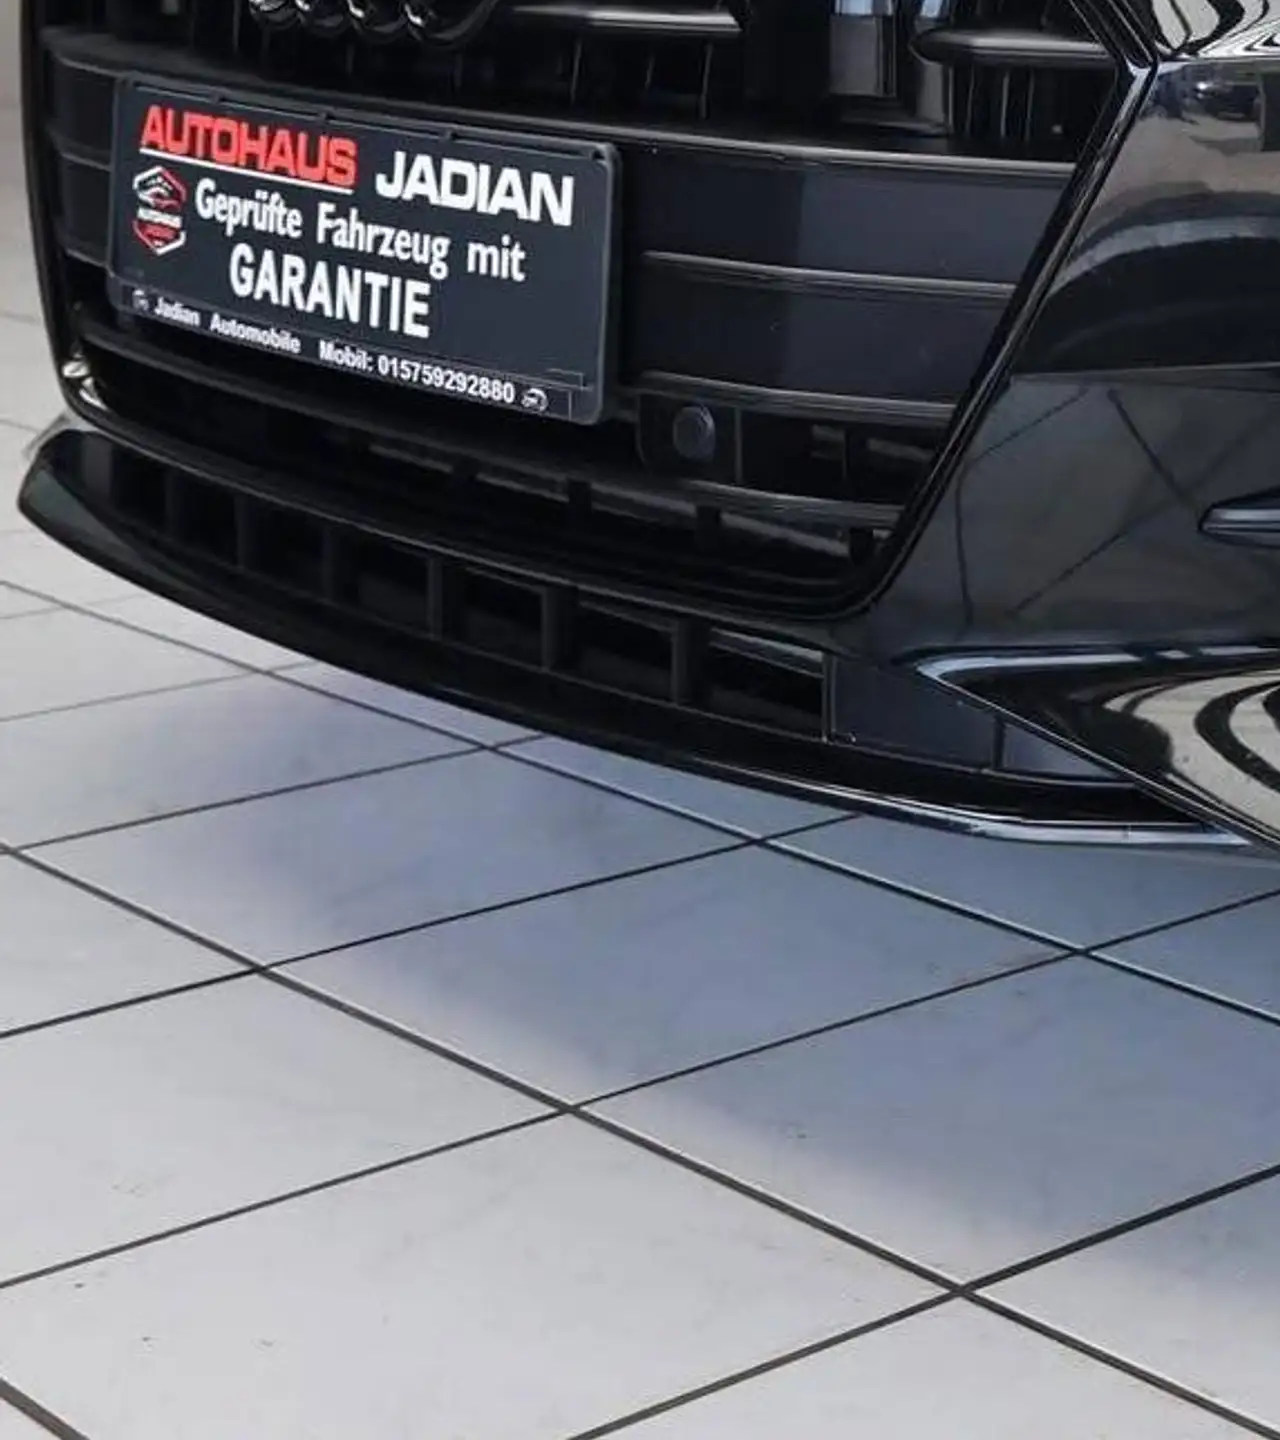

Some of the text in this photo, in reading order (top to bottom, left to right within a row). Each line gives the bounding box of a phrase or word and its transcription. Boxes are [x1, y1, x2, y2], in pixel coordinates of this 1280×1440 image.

[140, 105, 575, 227] AUTOHAUS JADIAN
[194, 177, 527, 282] Geprüfte Fahrzeug mit
[229, 243, 431, 338] GARANTIE
[154, 296, 516, 404] Jadian Automobile Mobil: 015759292880
